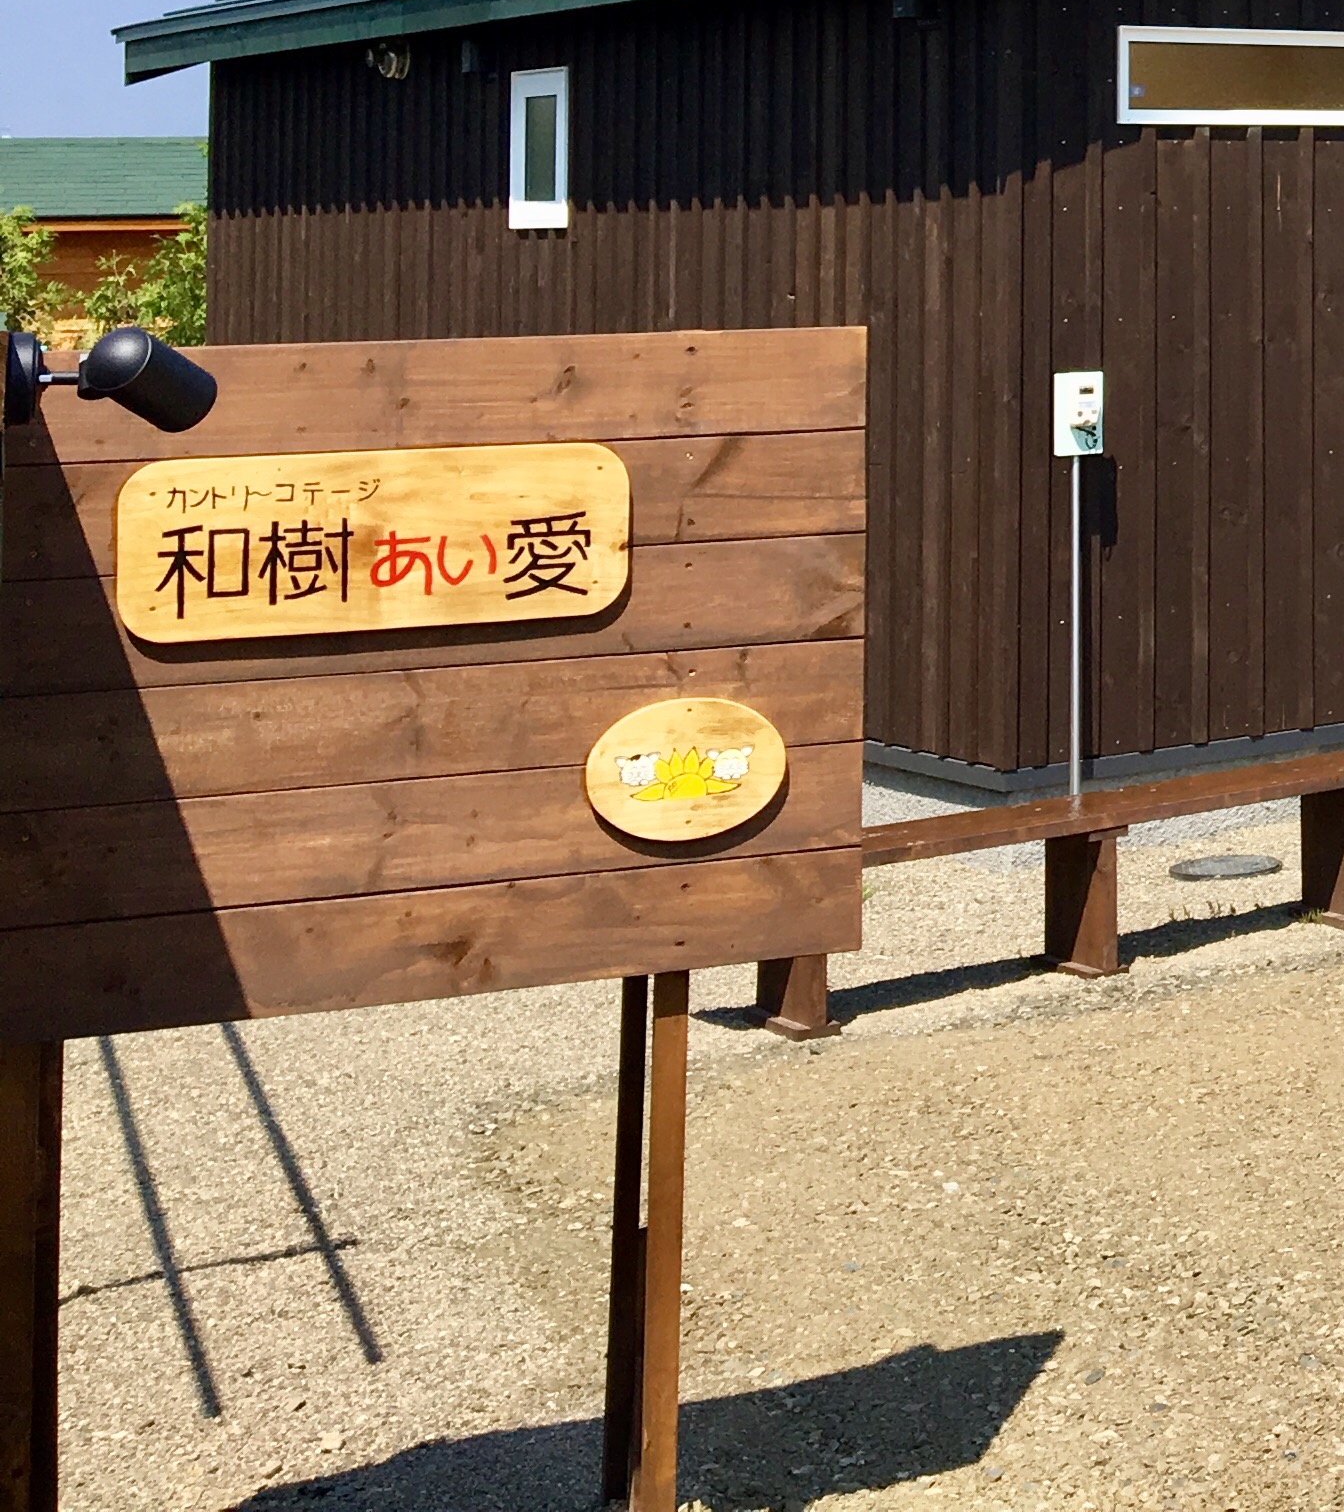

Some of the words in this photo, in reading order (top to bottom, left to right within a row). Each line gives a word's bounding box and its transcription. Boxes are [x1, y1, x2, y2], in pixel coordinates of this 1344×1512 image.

[155, 511, 592, 620] 和樹あい愛
